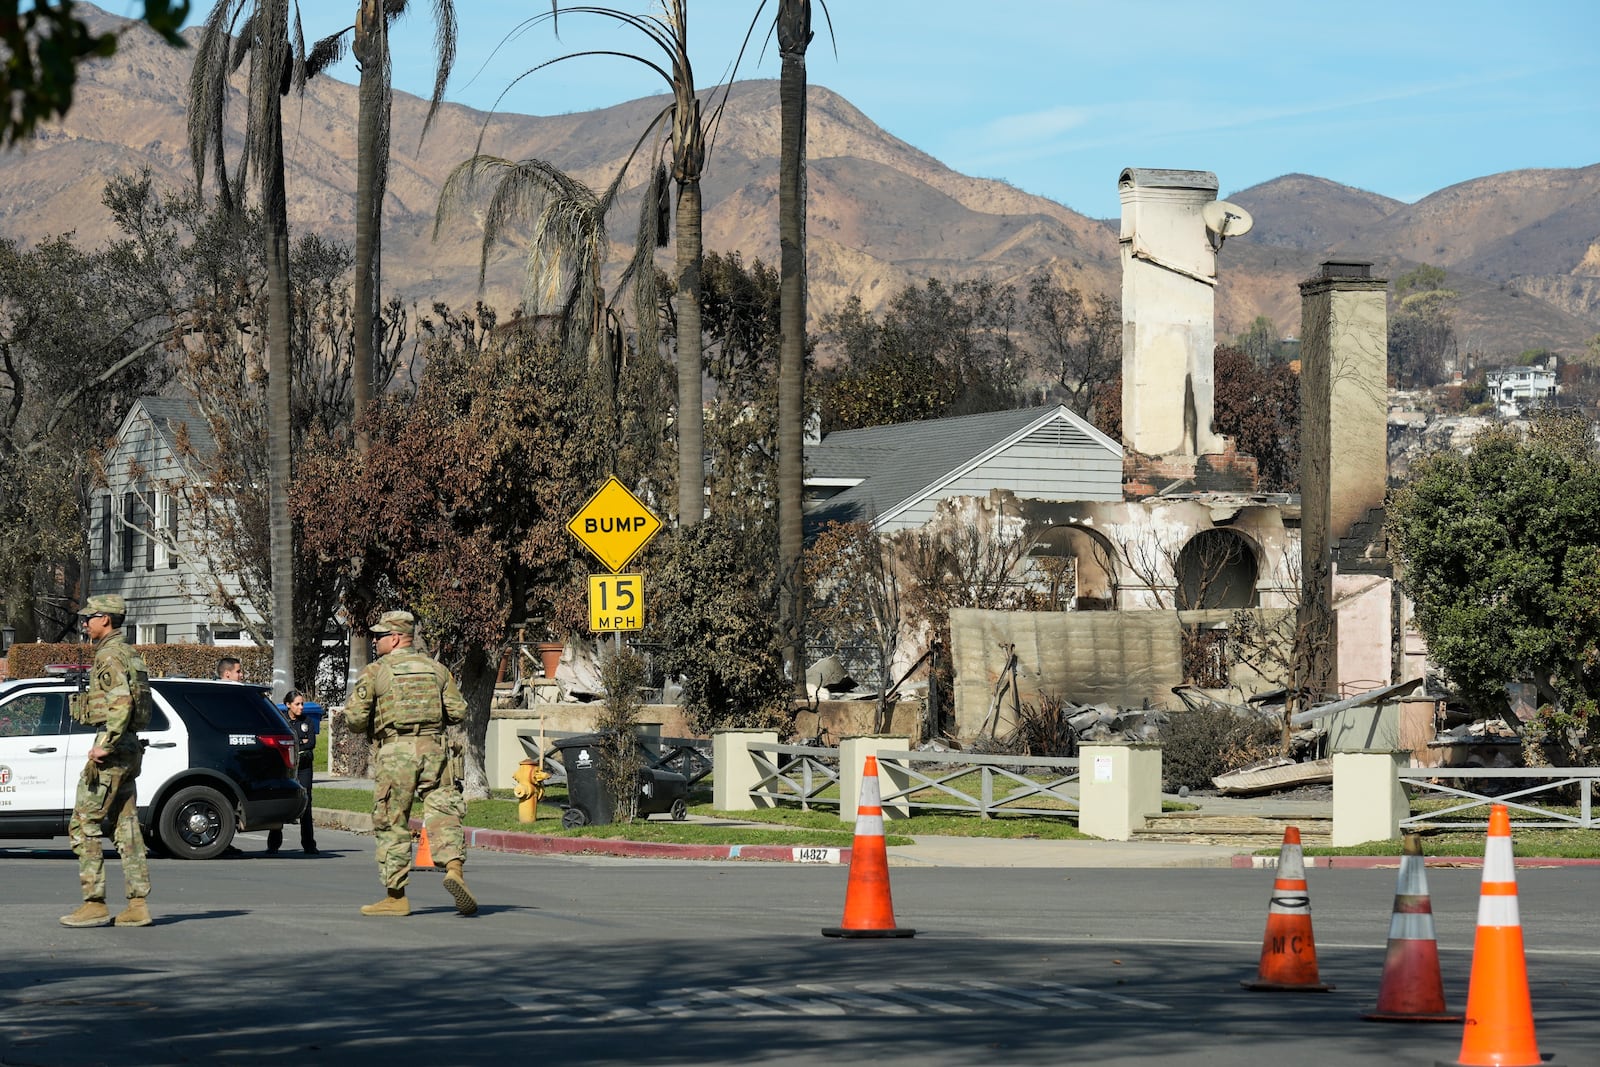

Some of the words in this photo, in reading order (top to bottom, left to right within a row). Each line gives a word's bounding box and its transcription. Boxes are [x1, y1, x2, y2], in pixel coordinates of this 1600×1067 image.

[585, 517, 646, 533] BUMP
[599, 581, 635, 611] 15
[599, 616, 635, 628] MPH
[800, 849, 828, 860] 14827
